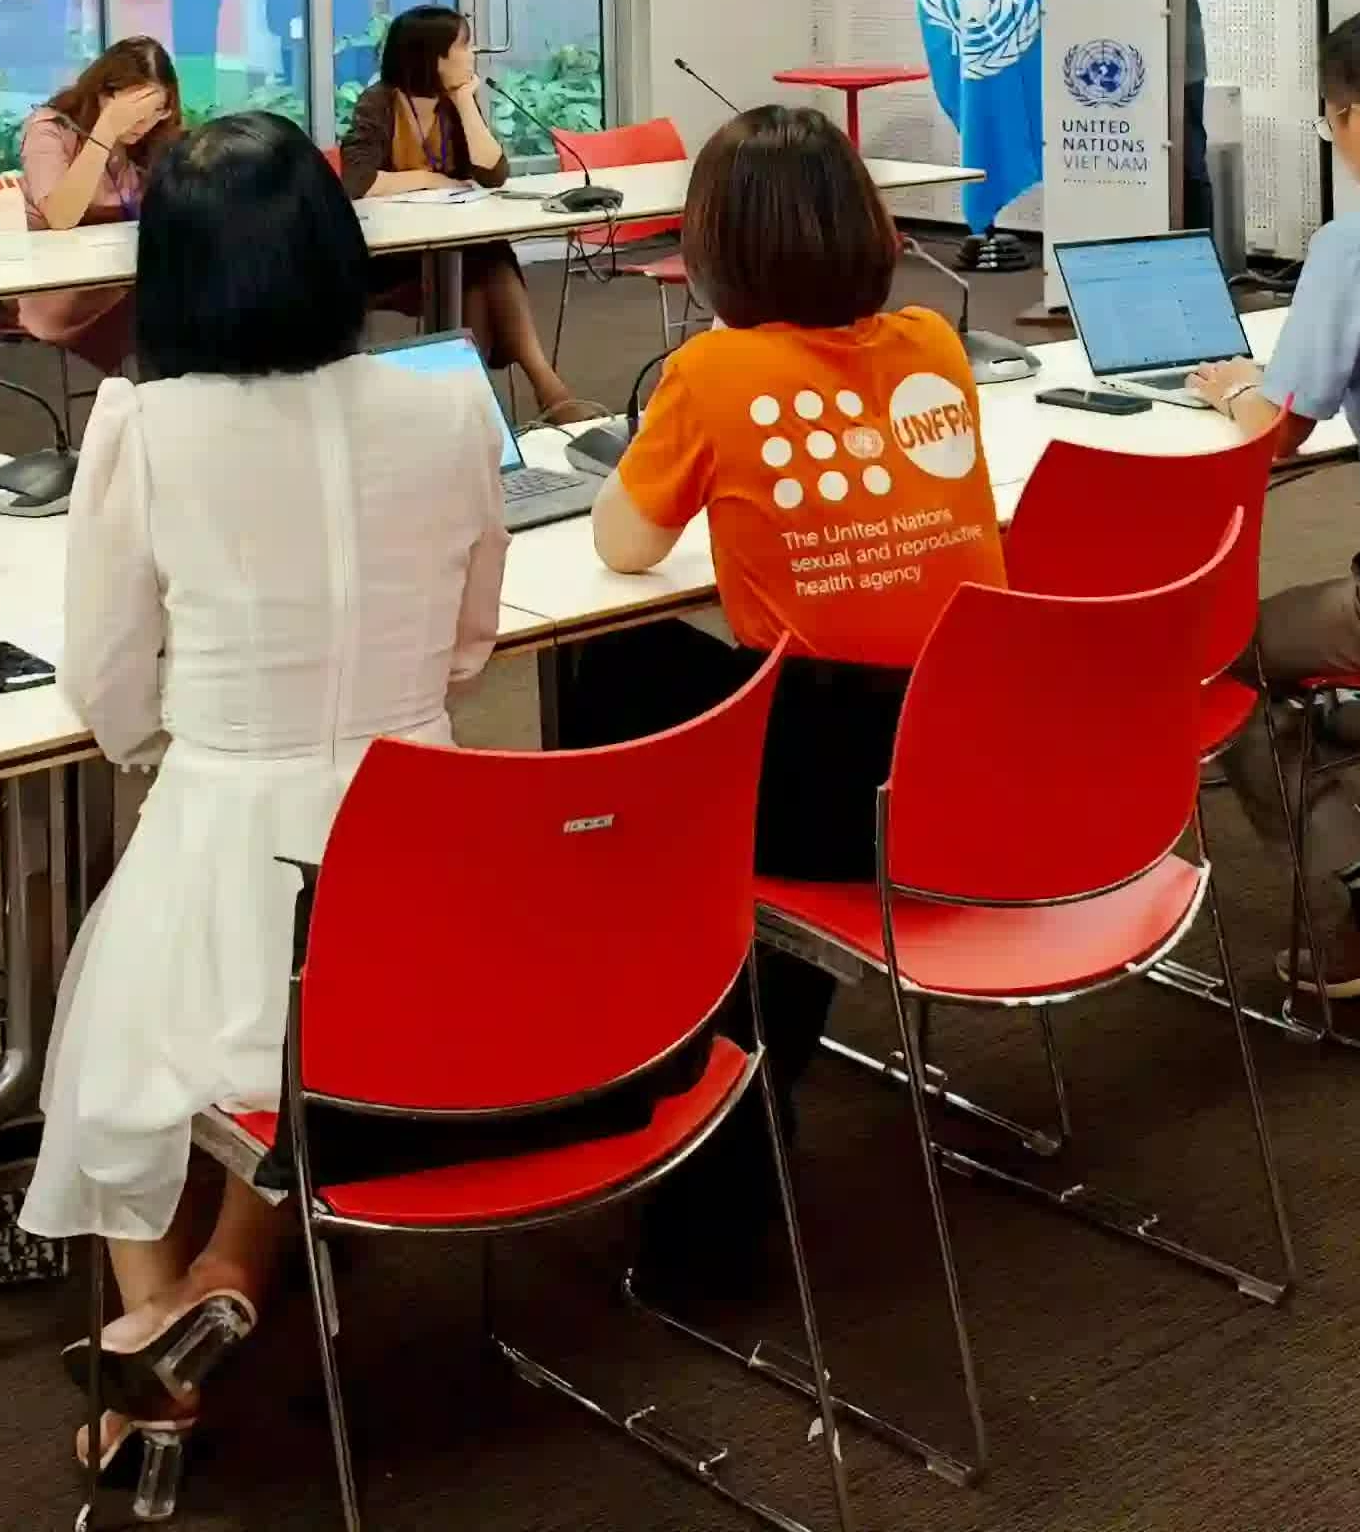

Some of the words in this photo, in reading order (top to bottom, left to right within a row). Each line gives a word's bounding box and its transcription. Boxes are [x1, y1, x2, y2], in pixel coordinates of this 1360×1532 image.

[1062, 119, 1130, 134] UNITED
[1063, 137, 1144, 152] NATIONS
[1064, 155, 1100, 170] VIET
[1107, 156, 1147, 171] NAM
[894, 400, 973, 449] UNFPA
[782, 531, 819, 551] The
[824, 521, 888, 544] United
[893, 508, 953, 533] Nations
[791, 545, 851, 573] sexual
[856, 544, 890, 563] and
[896, 524, 983, 557] reproductive
[795, 572, 854, 597] health
[860, 564, 921, 592] agency
